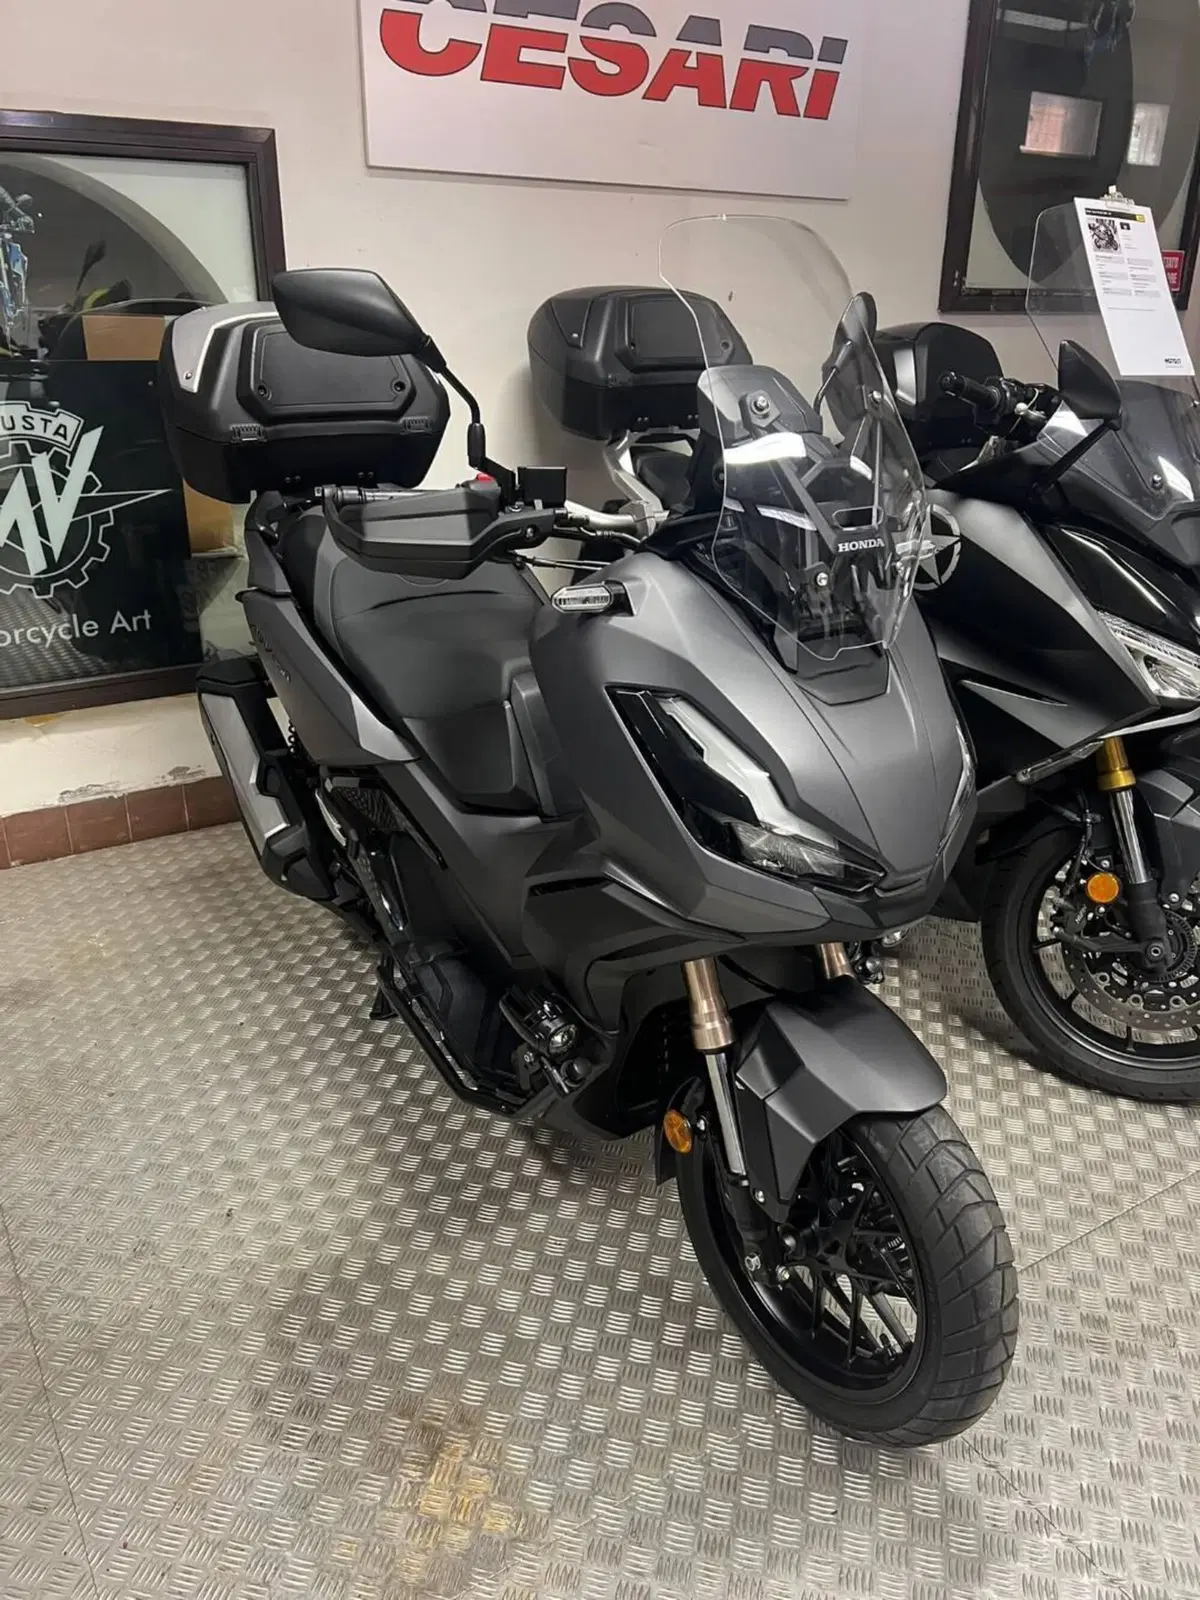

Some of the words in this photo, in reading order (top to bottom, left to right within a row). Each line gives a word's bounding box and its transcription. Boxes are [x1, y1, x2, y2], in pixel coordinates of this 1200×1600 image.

[380, 0, 848, 120] CESARI
[837, 538, 885, 553] HONDA
[110, 609, 152, 634] Art
